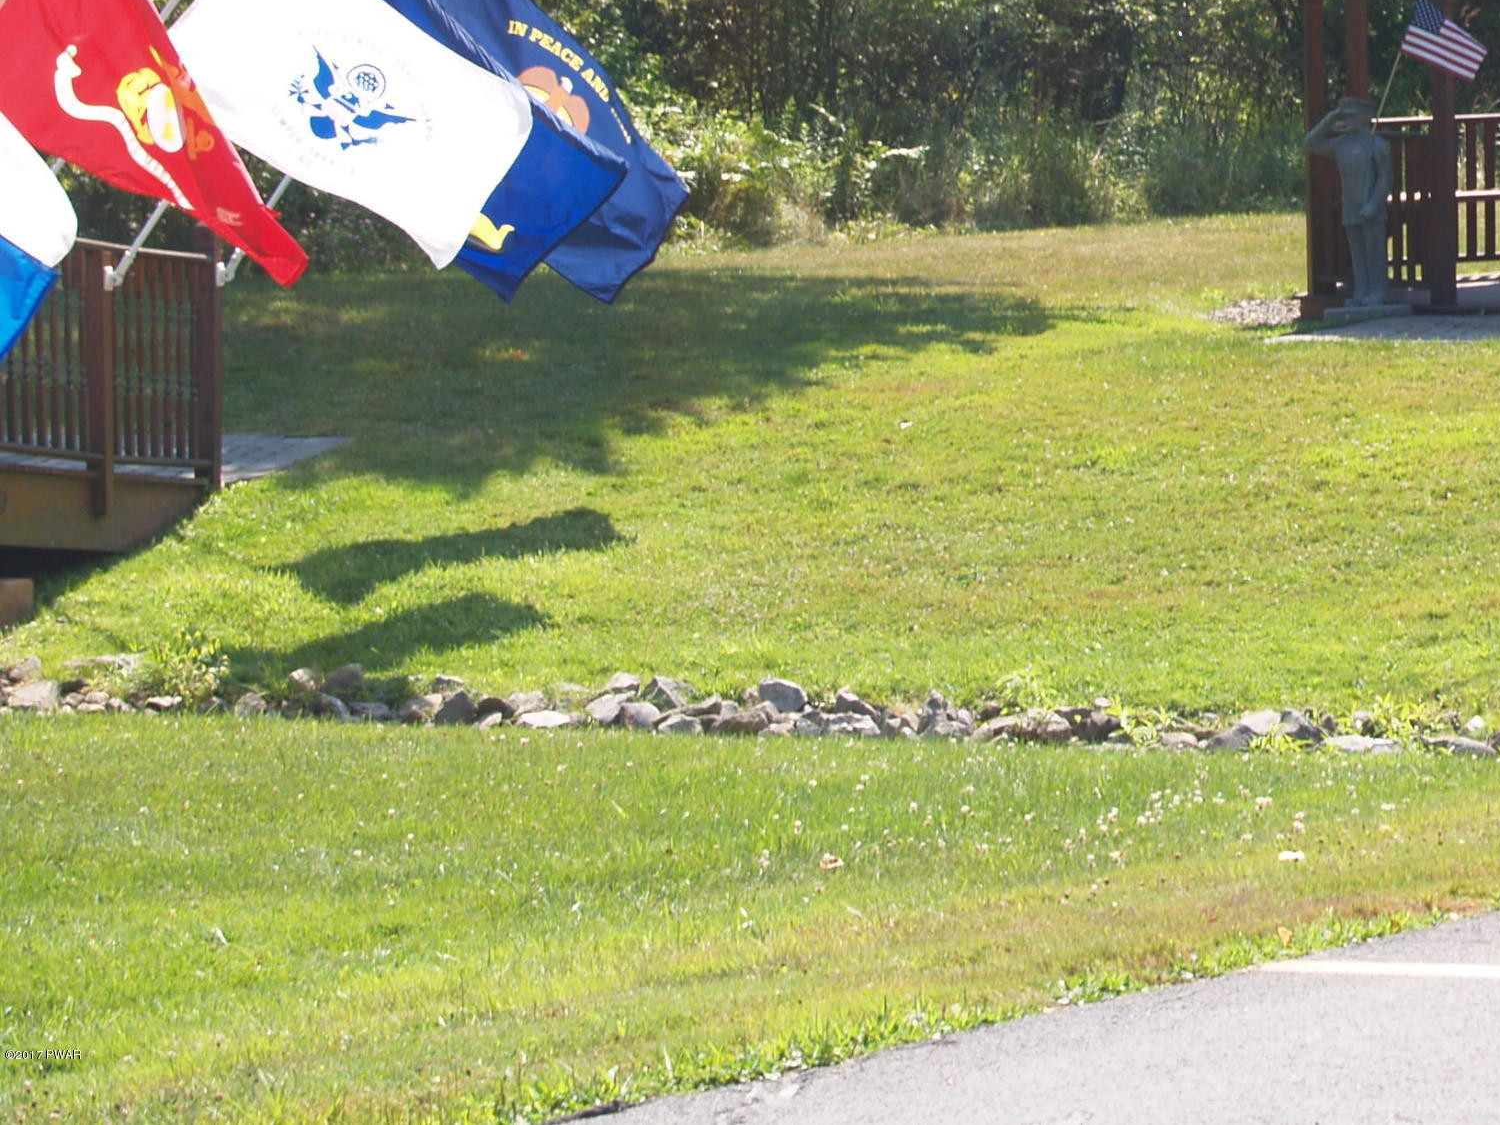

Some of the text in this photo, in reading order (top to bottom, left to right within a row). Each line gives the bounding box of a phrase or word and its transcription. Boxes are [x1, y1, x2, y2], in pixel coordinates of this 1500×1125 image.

[508, 20, 610, 103] IN PEACE AND
